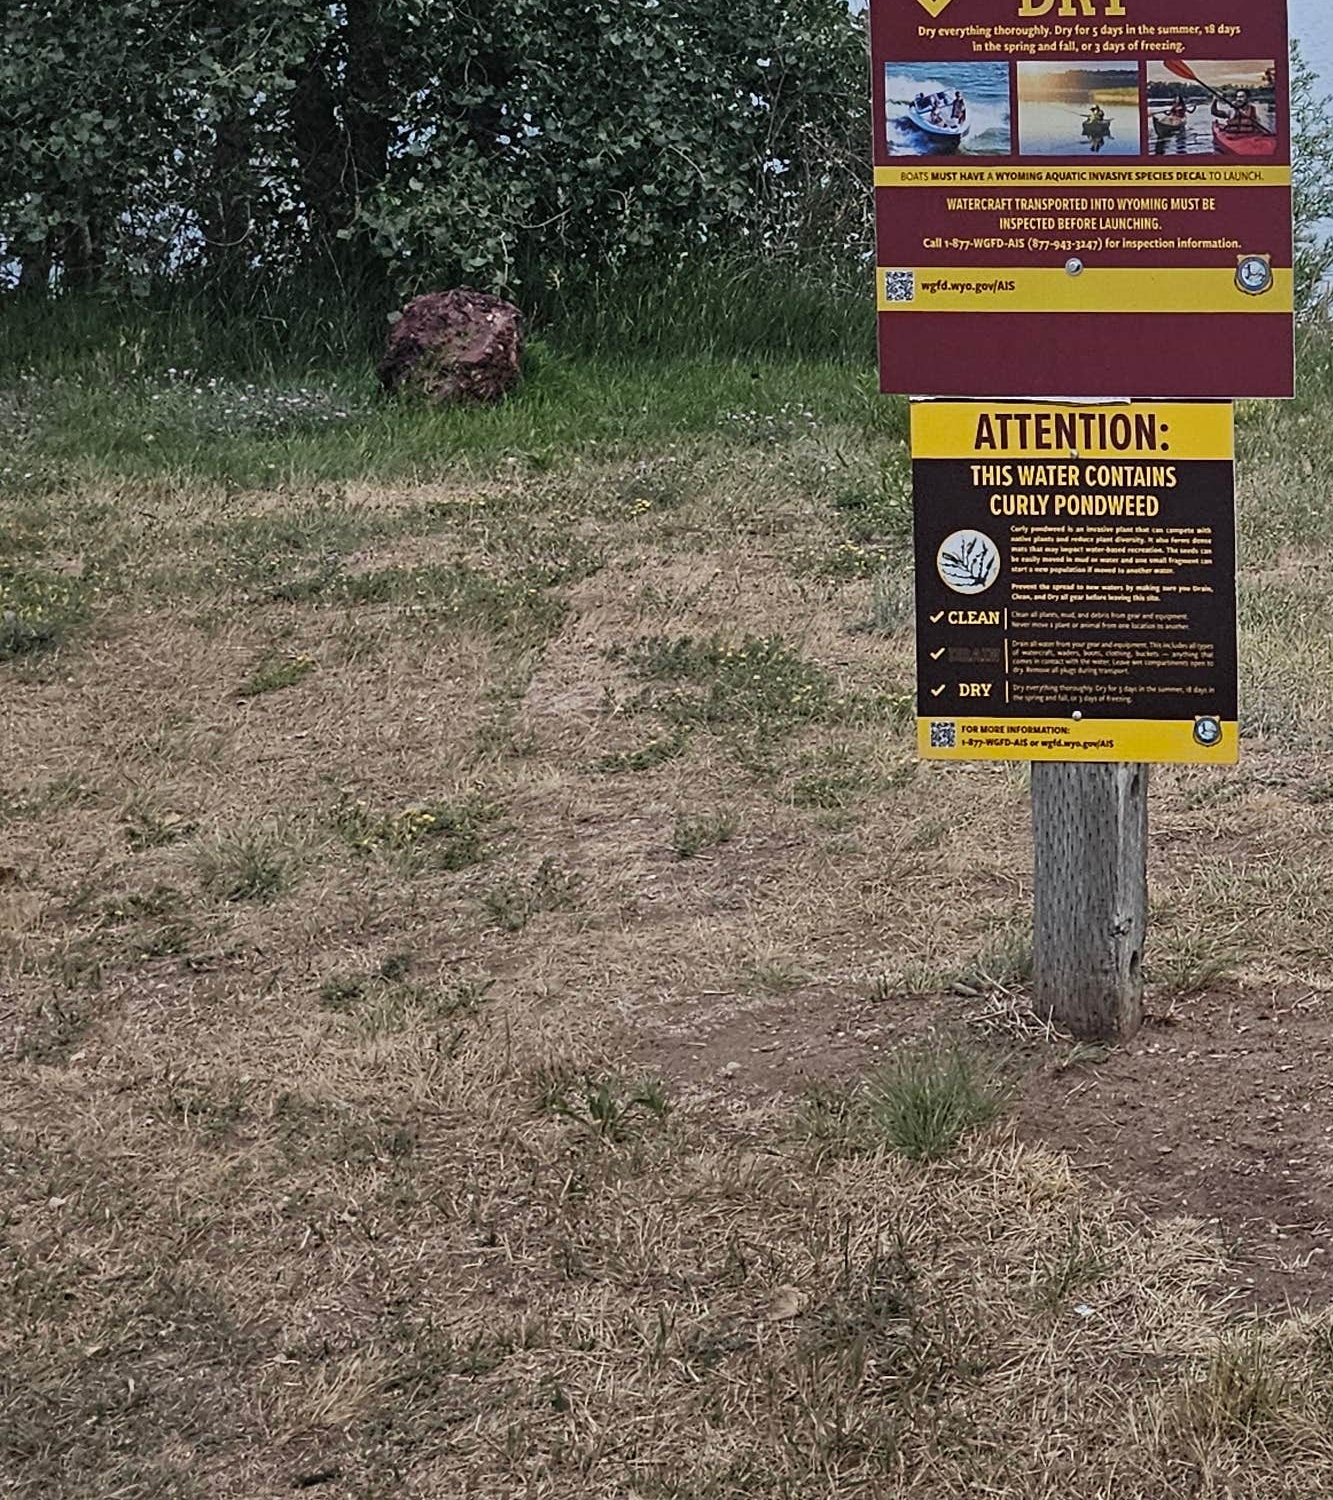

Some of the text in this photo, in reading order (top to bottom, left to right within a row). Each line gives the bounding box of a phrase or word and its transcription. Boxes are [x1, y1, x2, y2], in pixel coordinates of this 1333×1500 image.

[918, 24, 1240, 38] Dry everything thoroughly. Dry for 5 days in the summer, 18 days
[901, 171, 1263, 181] BOATS MUST HAVE A WYOMING AQUATIC INVASIVE SPECIES DECAL TO LAUNCH.
[946, 198, 1214, 209] WATERCRAFT TRANSPORTED INTO WYOMING MUST BE
[1000, 217, 1161, 229] INSPECTED BEFORE LAUNCHING.
[923, 237, 941, 247] Call
[944, 238, 1024, 249] 1-877-WGFD-AIS
[1105, 237, 1119, 247] for
[1122, 237, 1174, 250] inspection
[1177, 237, 1241, 247] information.
[921, 280, 1014, 293] wgfd.wyo.gov/AIS
[974, 412, 1168, 450] ATTENTION:
[970, 465, 1176, 486] THIS WATER CONTAINS
[990, 494, 1158, 516] CURLY PONDWEED
[948, 611, 999, 624] CLEAN
[959, 683, 991, 696] DRY
[1007, 726, 1069, 734] INFORMATION:
[962, 738, 1027, 748] 1-877-WGFD-AIS
[1041, 738, 1113, 749] wgfd.wyo.gov/AIS
